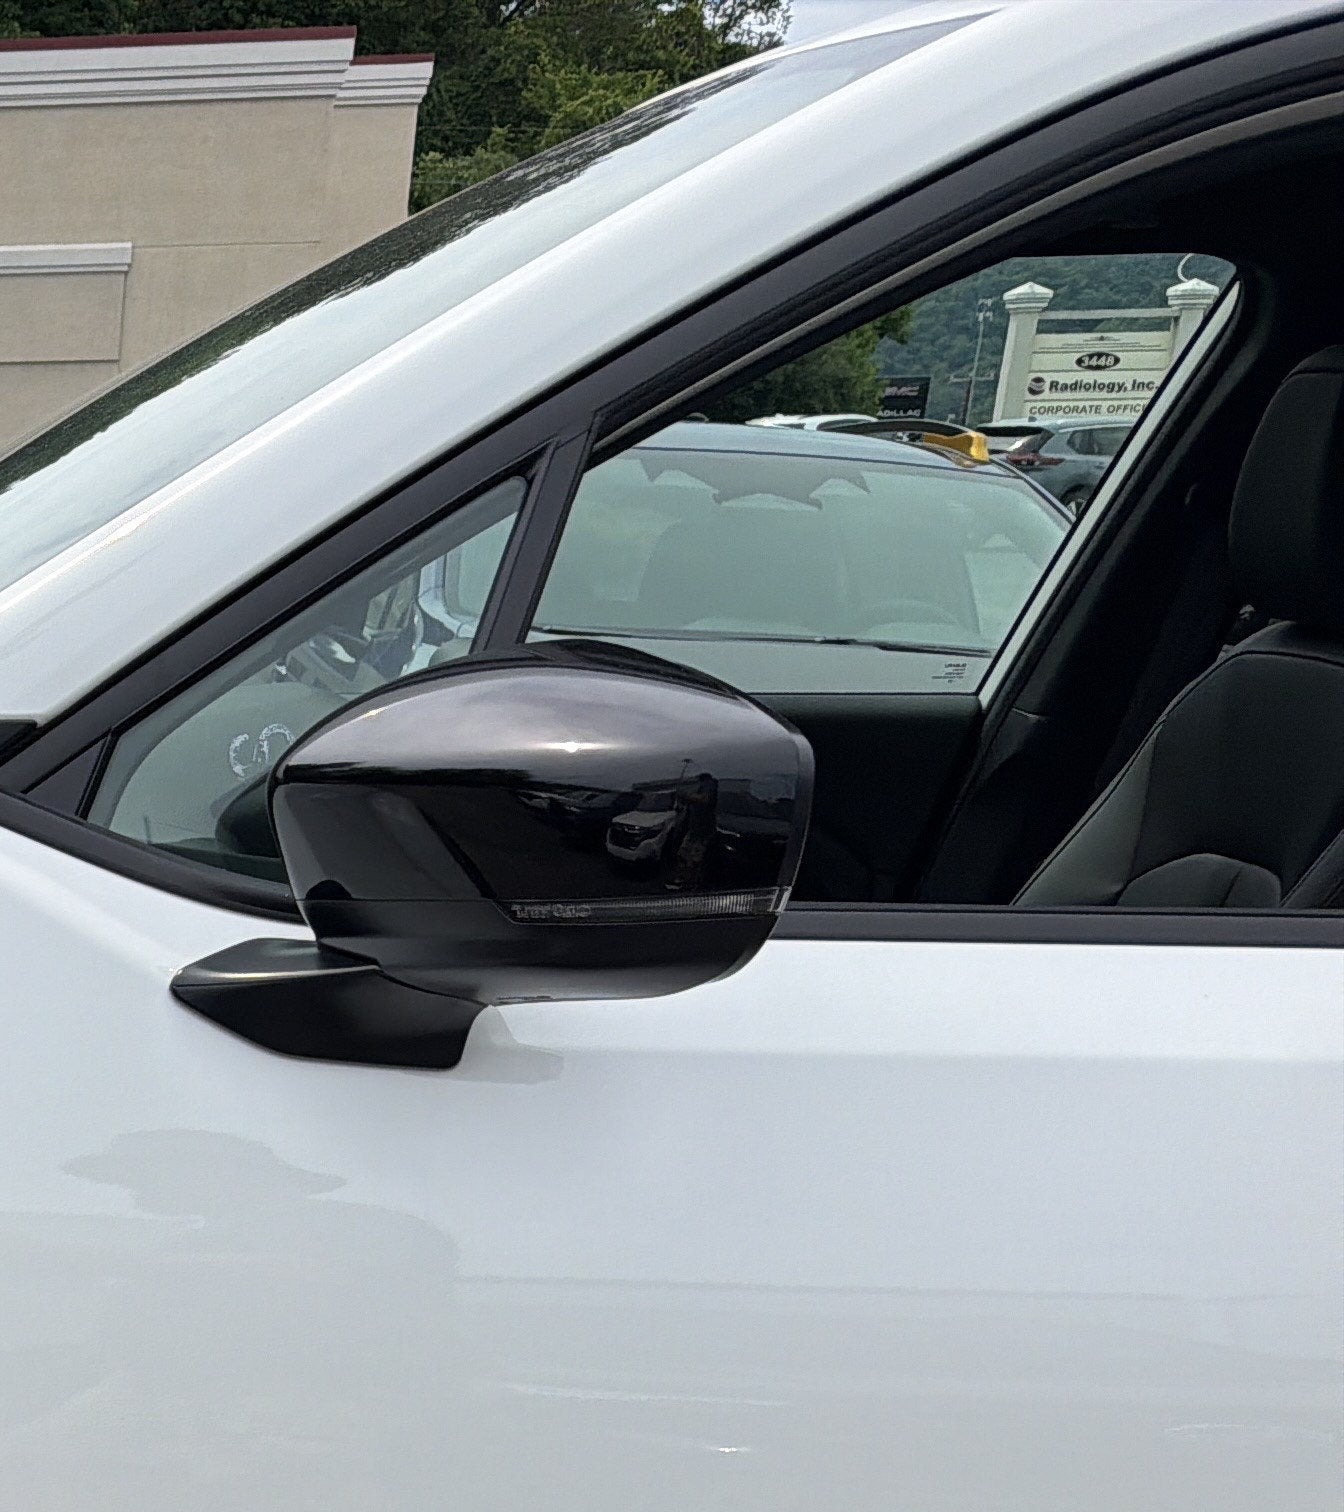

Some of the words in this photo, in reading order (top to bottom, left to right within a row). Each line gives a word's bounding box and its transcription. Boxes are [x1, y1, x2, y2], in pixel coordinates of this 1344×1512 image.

[1081, 355, 1115, 367] 3448
[1049, 379, 1128, 393] Radiology,
[1130, 378, 1159, 391] Inc.
[876, 409, 922, 417] ADILLAC
[1029, 404, 1102, 415] CORPORATE
